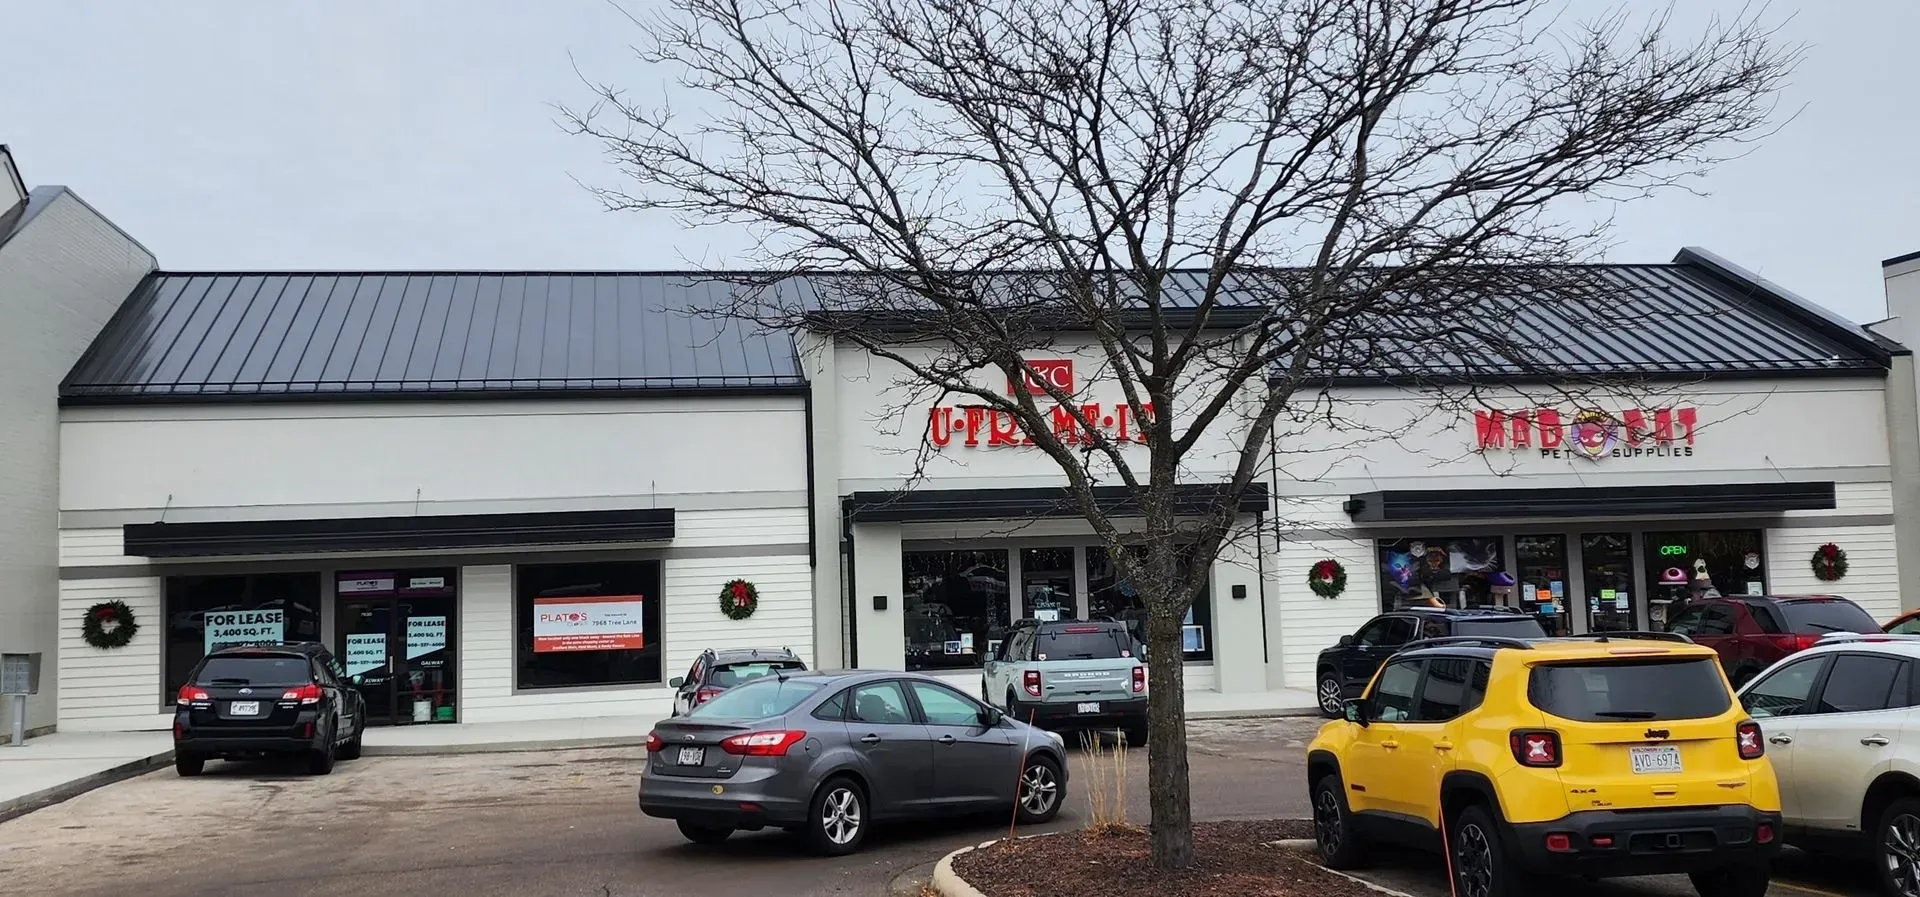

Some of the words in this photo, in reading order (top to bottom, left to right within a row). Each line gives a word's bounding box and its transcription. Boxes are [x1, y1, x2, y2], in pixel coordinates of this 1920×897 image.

[1473, 407, 1564, 449] MAD
[1622, 407, 1698, 449] CAT
[1541, 449, 1571, 459] PET
[1612, 447, 1693, 458] SUPPLIES
[1660, 545, 1687, 555] OPEN
[205, 614, 236, 627] FOR
[238, 612, 282, 625] LEASE
[213, 628, 241, 638] 3,400
[243, 628, 260, 637] SQ.
[261, 627, 275, 635] FT.
